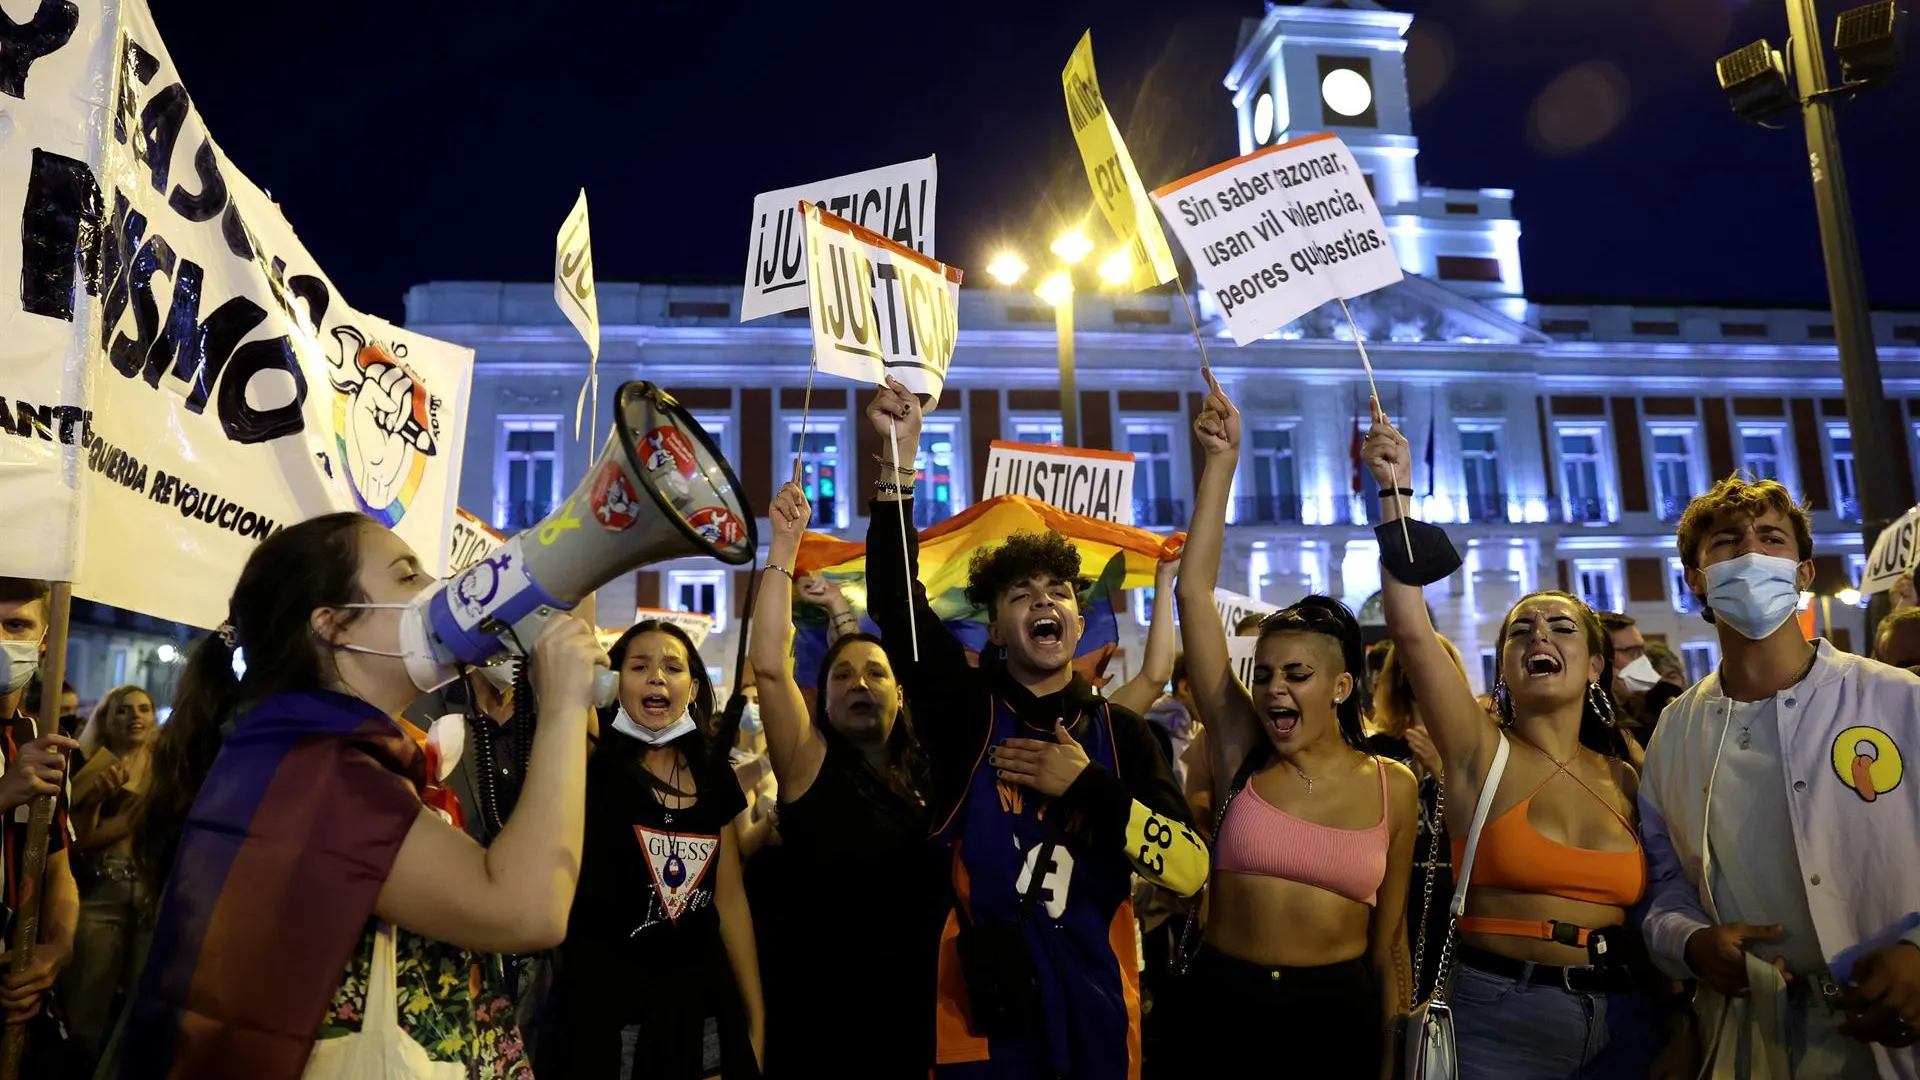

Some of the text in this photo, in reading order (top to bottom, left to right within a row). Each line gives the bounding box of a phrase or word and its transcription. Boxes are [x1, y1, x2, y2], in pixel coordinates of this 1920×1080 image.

[1179, 196, 1218, 227] Sin
[1217, 172, 1274, 212] saber
[1202, 230, 1255, 267] usan
[1253, 209, 1284, 242] vil
[1216, 262, 1289, 317] peores
[1290, 246, 1320, 275] qu
[149, 470, 284, 541] REVOLUCION
